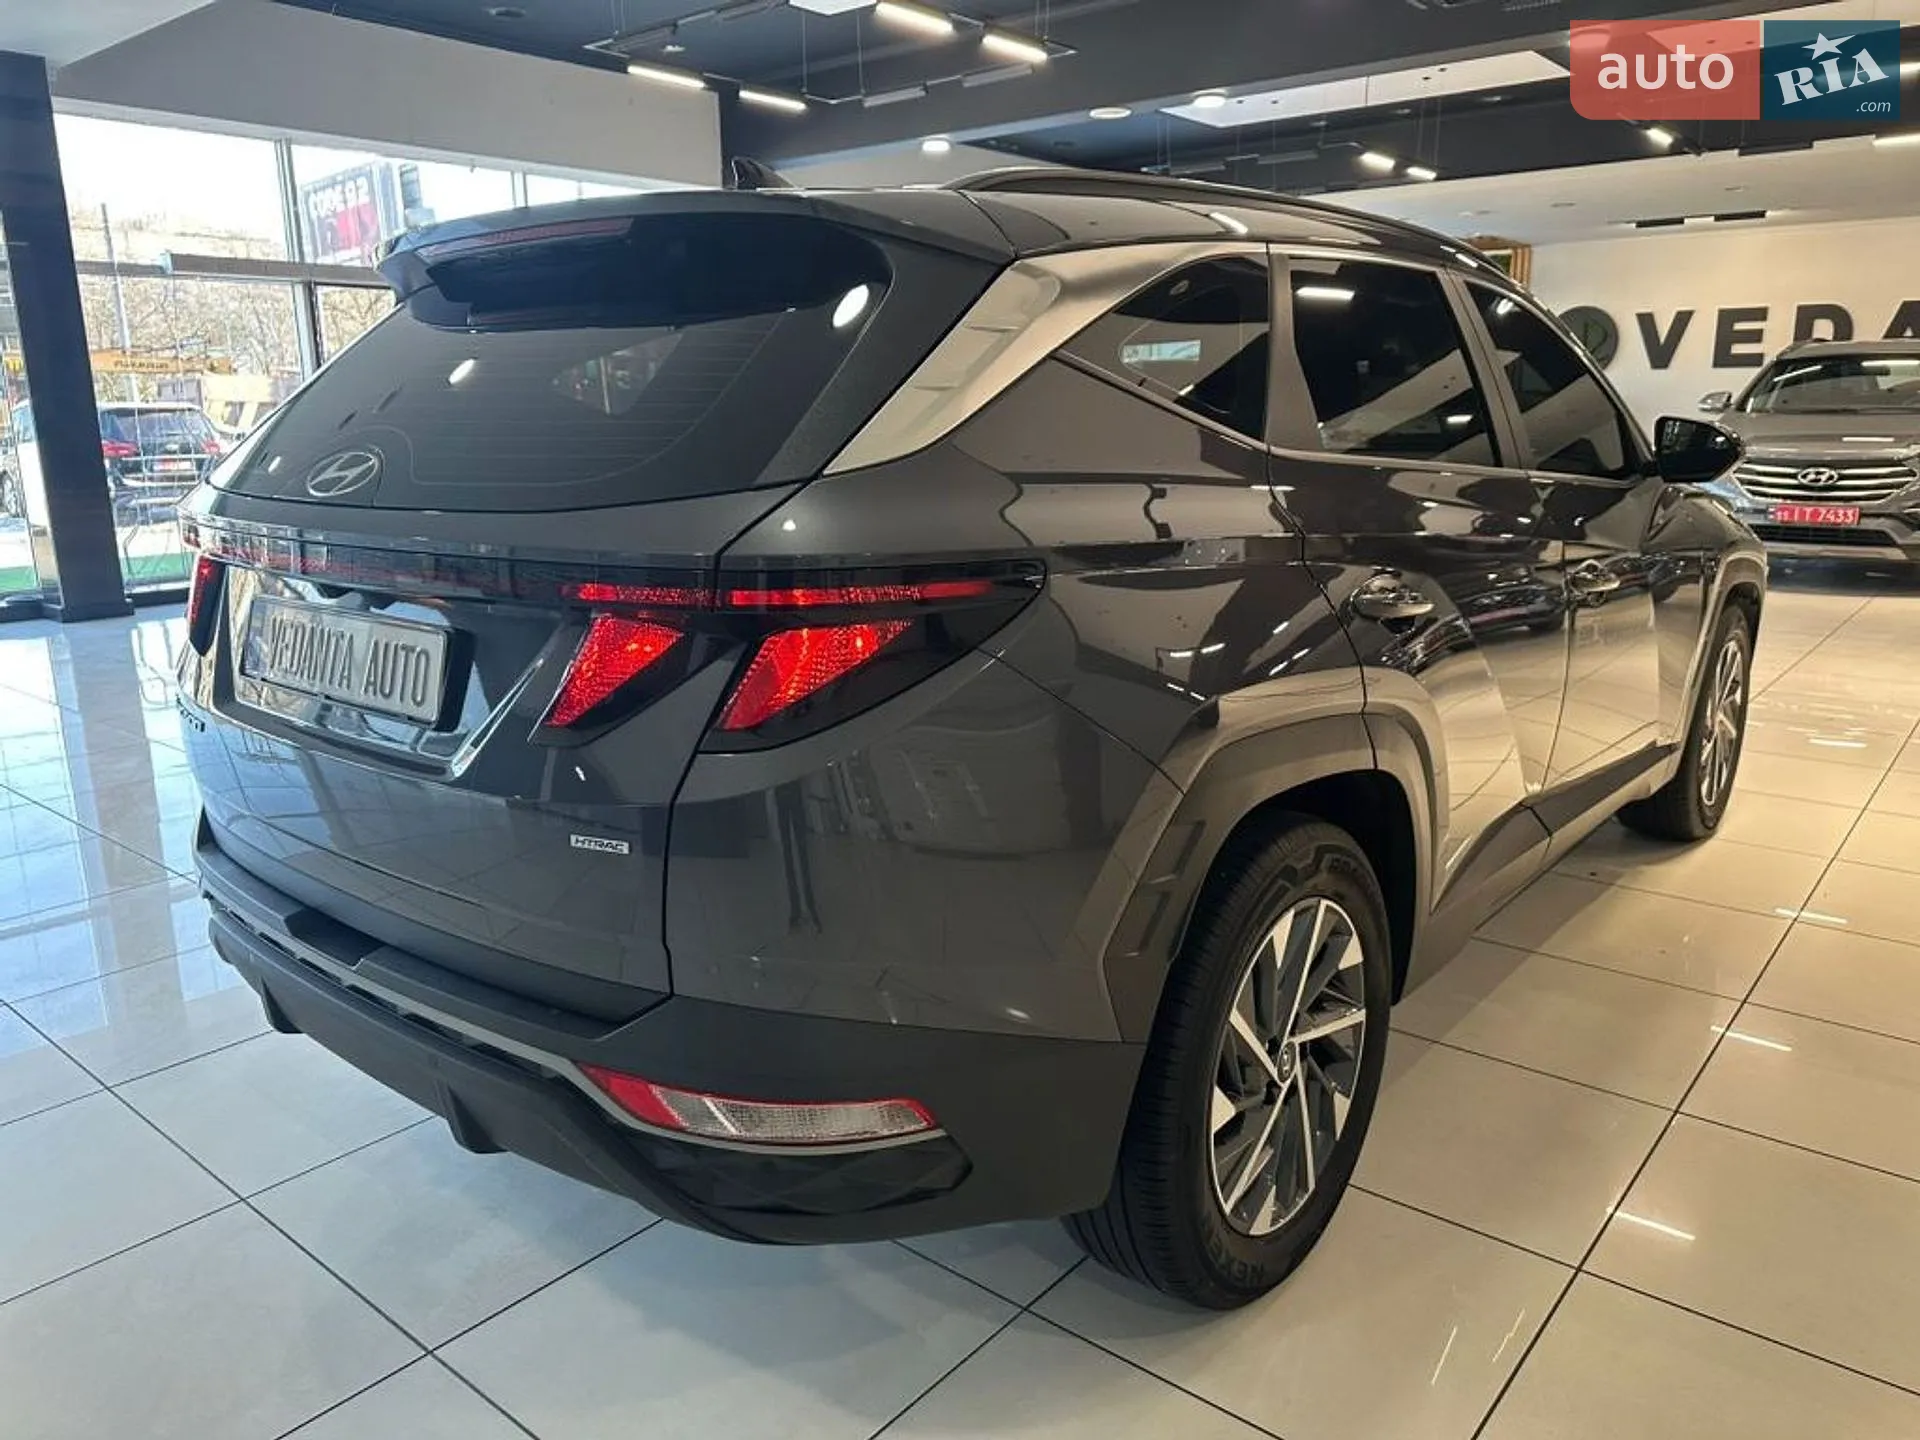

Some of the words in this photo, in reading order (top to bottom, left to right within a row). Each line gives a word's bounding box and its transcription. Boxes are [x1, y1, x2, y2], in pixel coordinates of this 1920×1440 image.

[269, 613, 354, 691] VEDANTA
[361, 637, 430, 708] AUTO
[574, 836, 625, 853] HTRAC
